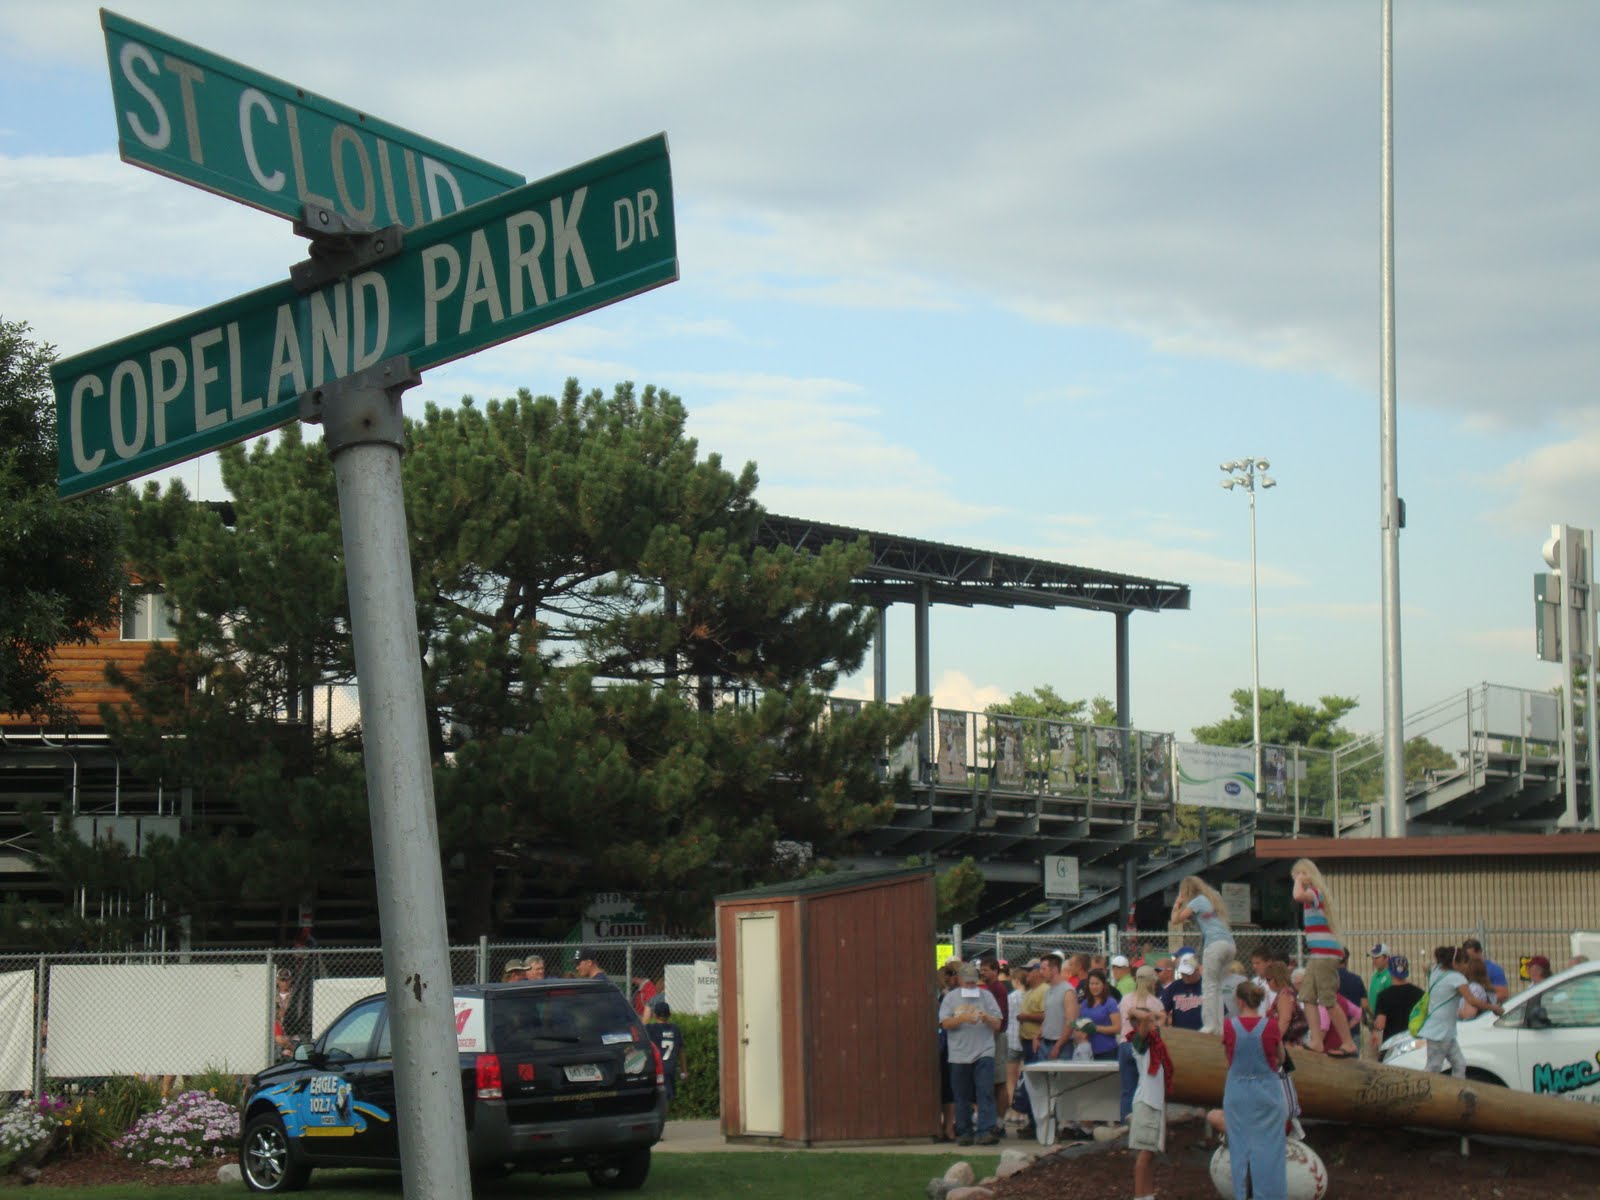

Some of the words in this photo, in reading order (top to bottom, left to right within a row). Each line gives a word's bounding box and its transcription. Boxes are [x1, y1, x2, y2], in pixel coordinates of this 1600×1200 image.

[120, 42, 204, 164] ST
[239, 87, 464, 228] CLOUD
[70, 271, 390, 473] COPELAND
[421, 187, 596, 347] PARK
[613, 188, 659, 252] DR
[661, 1040, 674, 1060] 7
[310, 1076, 338, 1094] EAGLE
[310, 1098, 331, 1112] 102.7
